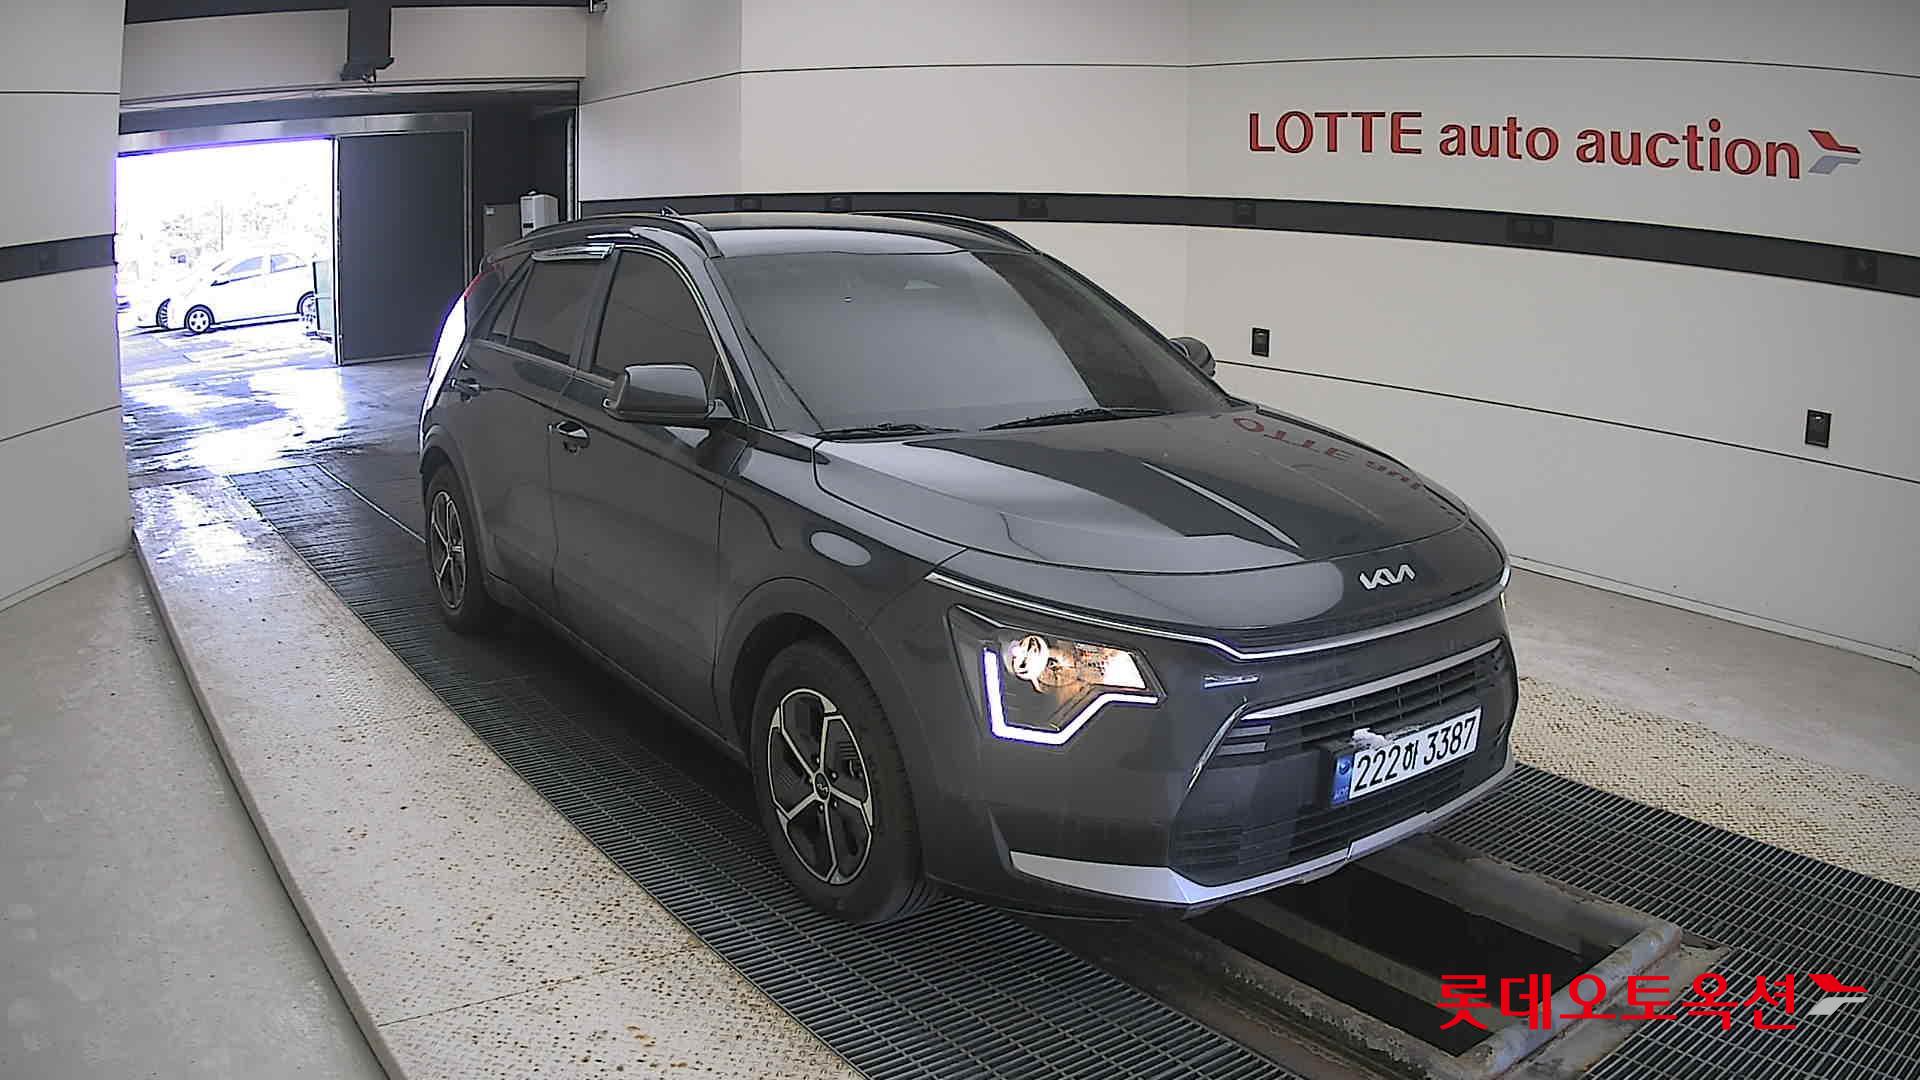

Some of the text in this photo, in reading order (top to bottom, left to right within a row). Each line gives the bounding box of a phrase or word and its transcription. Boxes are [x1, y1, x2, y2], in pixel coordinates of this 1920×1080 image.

[1248, 111, 1801, 179] LOTTE auto auction
[1423, 716, 1477, 765] 3387
